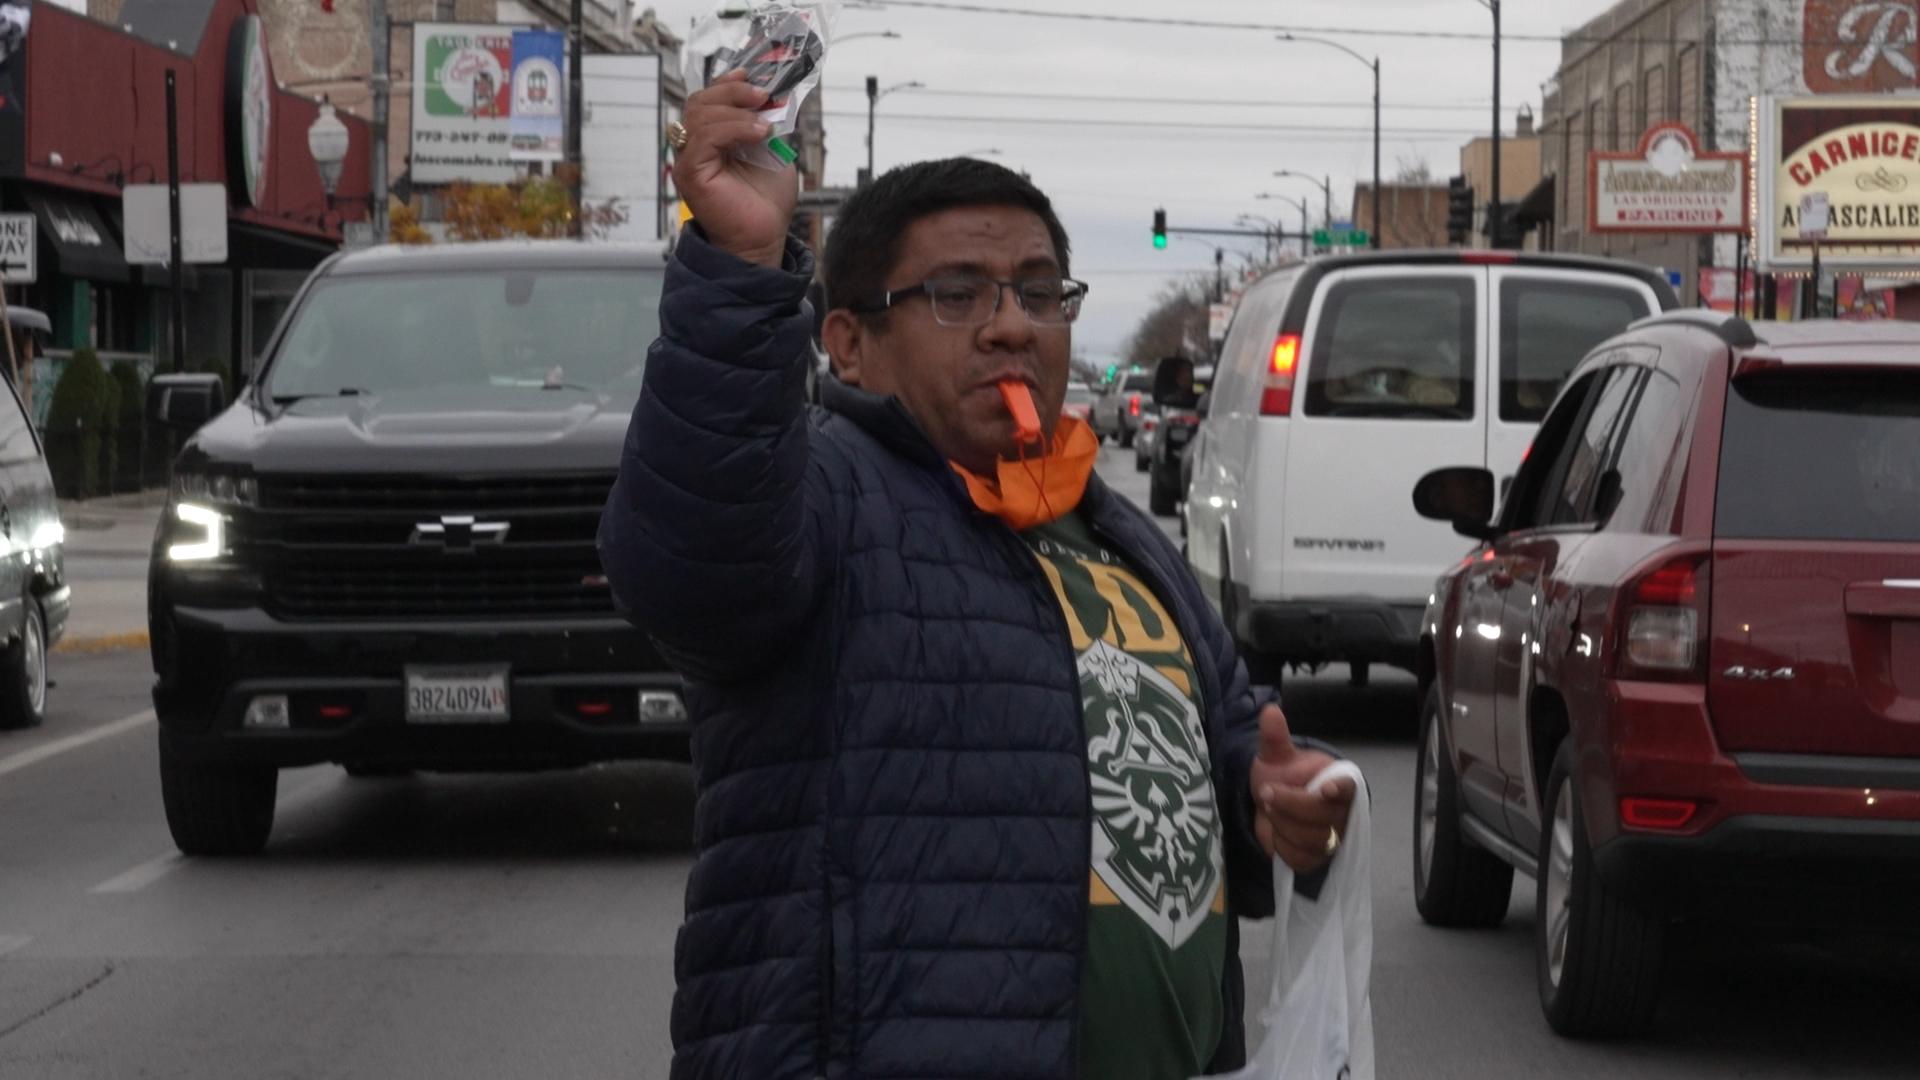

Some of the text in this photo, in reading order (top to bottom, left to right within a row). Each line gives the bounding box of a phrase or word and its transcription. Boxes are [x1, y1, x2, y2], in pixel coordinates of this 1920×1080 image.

[1789, 131, 1920, 187] CARNICE
[1782, 203, 1920, 228] AASCALIE
[1723, 665, 1795, 680] 4x4
[410, 686, 492, 711] 3824094
